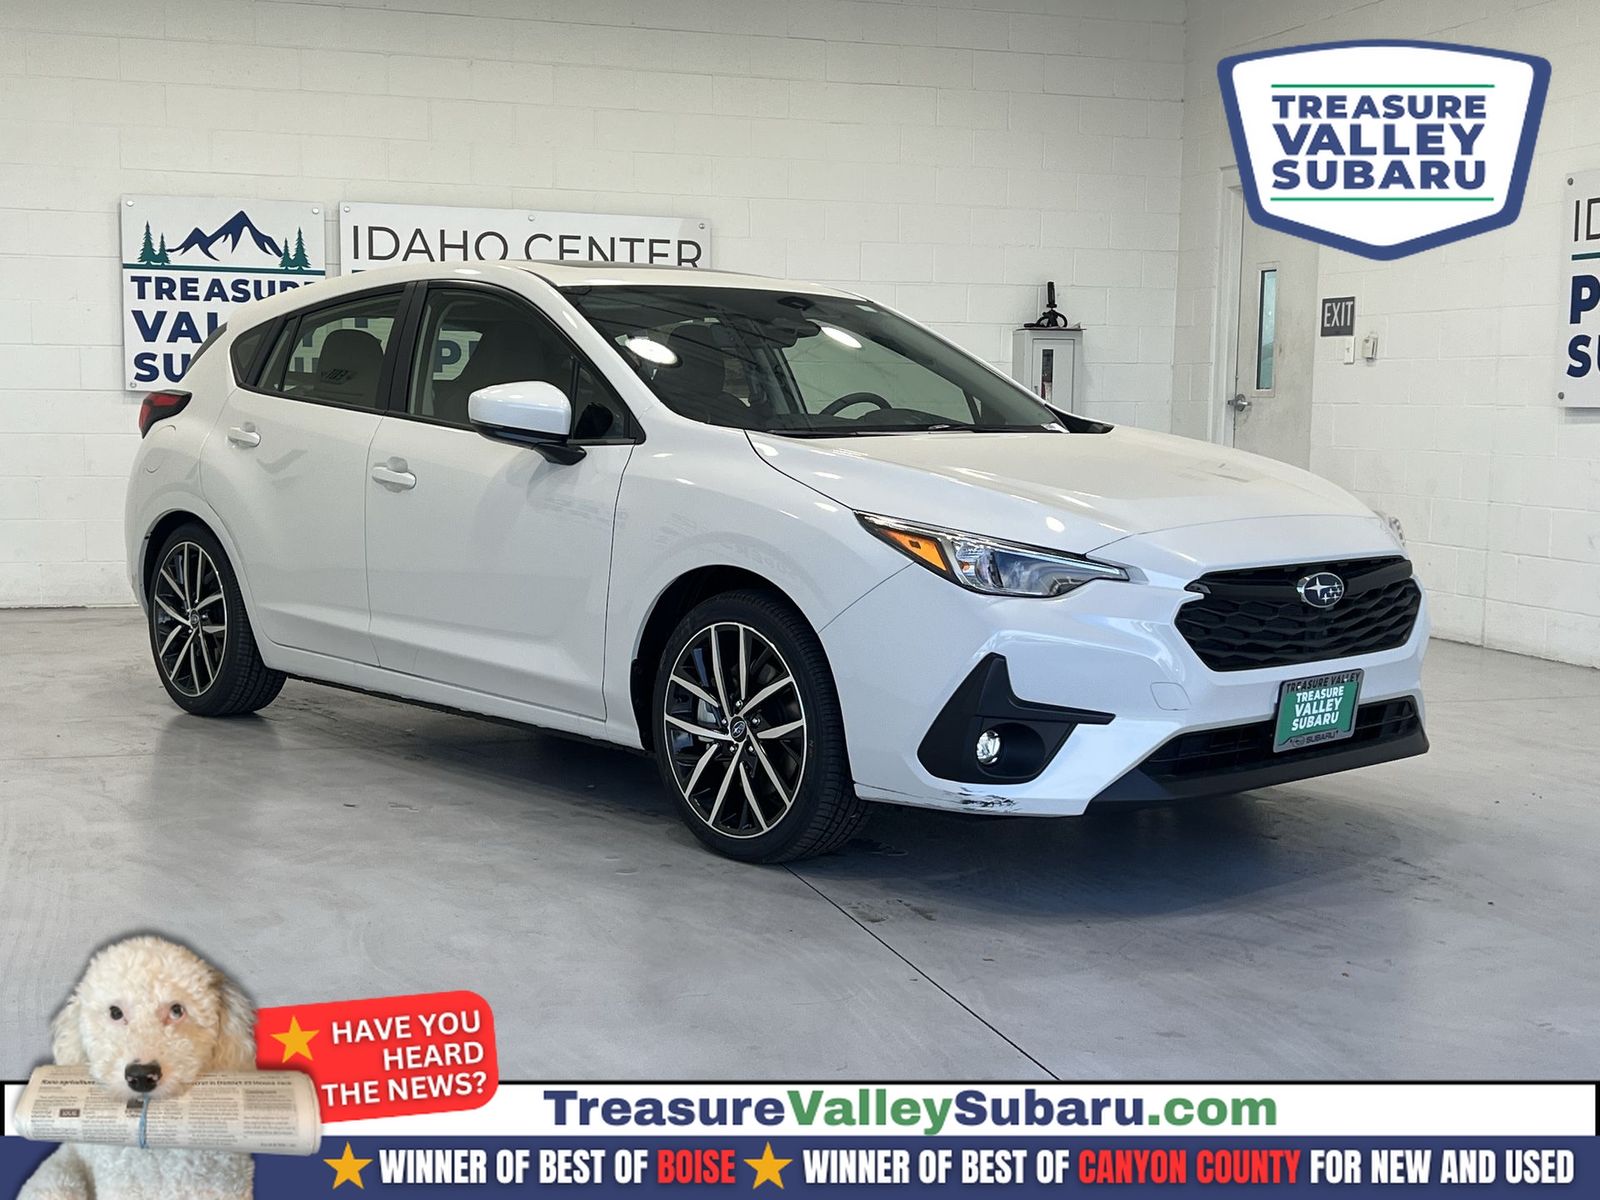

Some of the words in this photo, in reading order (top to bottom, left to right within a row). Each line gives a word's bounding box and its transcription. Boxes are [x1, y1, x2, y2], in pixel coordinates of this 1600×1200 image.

[352, 225, 509, 263] IDAHO
[524, 233, 704, 269] CENTER
[1323, 300, 1354, 328] EXIT
[1287, 677, 1329, 692] TREASURE
[1330, 672, 1360, 685] VALLEY
[1296, 686, 1344, 703] TREASURE
[1295, 697, 1342, 717] VALLEY
[1291, 711, 1339, 731] SUBARU
[1306, 732, 1335, 744] SUBARU
